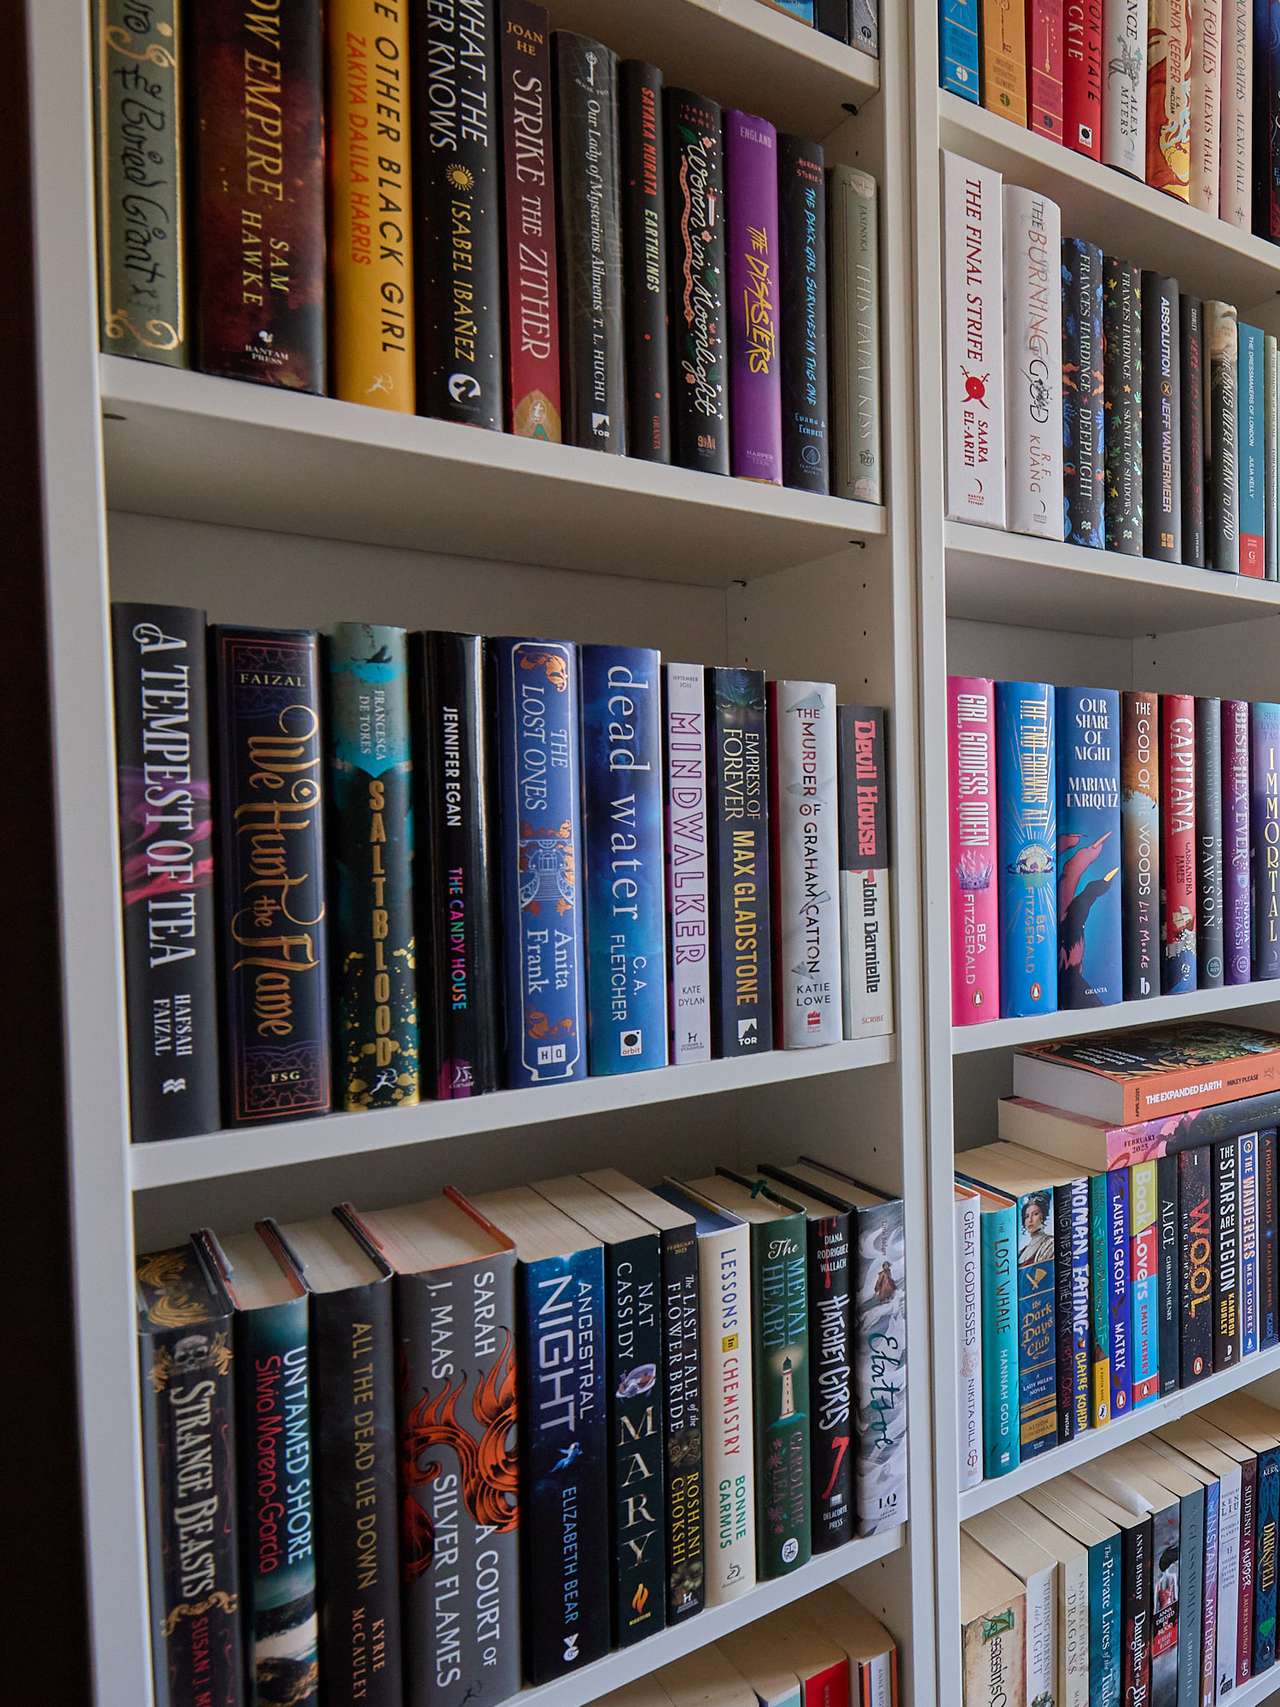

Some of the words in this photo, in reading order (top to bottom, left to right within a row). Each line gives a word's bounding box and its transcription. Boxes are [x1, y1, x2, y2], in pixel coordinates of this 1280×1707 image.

[346, 32, 367, 110] ZAKIYA
[374, 37, 400, 144] OTHER
[121, 100, 165, 184] Buried
[243, 49, 282, 200] EMPIRE
[513, 69, 546, 186] STRIKE
[641, 87, 656, 141] SAYAKA
[348, 112, 368, 184] DALILA
[643, 143, 656, 195] MURATA
[351, 192, 371, 265] HARRIS
[378, 157, 403, 268] BLACK
[519, 194, 542, 239] THE
[965, 179, 982, 220] THE
[123, 184, 169, 284] Giant
[241, 209, 261, 307] HAWKE
[448, 199, 472, 273] ISABEL
[645, 209, 660, 293] EARTHLINGS
[965, 225, 982, 286] FINAL
[270, 238, 289, 292] SAM
[380, 281, 405, 353] GIRL
[519, 247, 551, 361] ZITHER
[967, 293, 983, 362] STRIFE
[1160, 297, 1171, 377] ABSOLUTION
[963, 410, 975, 467] EL-ARIFI
[977, 419, 990, 463] SAARA
[1161, 398, 1171, 430] JEFF
[1030, 434, 1041, 493] KUANG
[1080, 409, 1093, 500] DEEPLIGHT
[1162, 433, 1172, 513] VANDERMEER
[132, 623, 187, 654] A
[240, 674, 306, 687] FAIZAL
[1079, 698, 1107, 714] OUR
[443, 707, 460, 778] JENNIFER
[522, 684, 546, 744] LOST
[608, 666, 649, 772] dead
[1075, 715, 1110, 730] SHARE
[1084, 730, 1103, 745] OF
[141, 665, 195, 830] TEMPEST
[551, 729, 568, 768] THE
[723, 728, 744, 822] FOREVER
[745, 733, 760, 804] EMPRESS
[854, 720, 877, 780] Devil
[1075, 746, 1111, 761] NIGHT
[1169, 718, 1194, 833] CAPITANA
[446, 783, 461, 826] EGAN
[520, 749, 547, 810] ONES
[1067, 793, 1120, 809] ENRIQUEZ
[1068, 777, 1118, 792] MARIANA
[670, 712, 706, 965] MINDWALKER
[747, 807, 760, 819] OF
[856, 786, 879, 856] House
[957, 802, 989, 847] QUEEN
[146, 840, 194, 884] OF
[610, 794, 645, 921] water
[733, 830, 755, 876] MAX
[1264, 748, 1280, 942] IMMORTAL
[449, 868, 463, 894] THE
[863, 879, 877, 917] John
[1202, 836, 1215, 928] DAWSON
[148, 893, 196, 968] TEA
[368, 780, 392, 1067] SALTBLOOD
[449, 900, 464, 955] CANDY
[733, 883, 757, 1006] GLADSTONE
[963, 893, 976, 984] FITZGERALD
[977, 923, 986, 954] BEA
[451, 959, 467, 1010] HOUSE
[527, 929, 549, 994] Frank
[555, 929, 573, 990] Anita
[610, 934, 626, 1021] FLETCHER
[796, 983, 830, 993] KATIE
[864, 921, 881, 994] Darnielle
[678, 995, 705, 1006] DYLAN
[681, 985, 701, 995] KATE
[796, 995, 830, 1006] LOWE
[154, 999, 171, 1056] FAIZAL
[174, 994, 192, 1056] HAFSAH
[622, 1046, 641, 1055] orbit
[738, 1037, 757, 1046] TOR
[271, 1071, 300, 1082] FSG
[1160, 1086, 1199, 1102] EXPANDED
[1199, 1079, 1223, 1093] EARTH
[1220, 1145, 1235, 1159] THE
[1220, 1159, 1235, 1219] STARS
[1242, 1177, 1256, 1260] WANDERERS
[1112, 1195, 1124, 1246] LAUREN
[1220, 1215, 1235, 1229] ARE
[427, 1282, 453, 1297] J.
[720, 1249, 738, 1329] LESSONS
[1113, 1248, 1125, 1296] GROFF
[1220, 1230, 1236, 1292] LEGION
[474, 1271, 496, 1358] SARAH
[617, 1262, 634, 1360] CASSIDY
[638, 1283, 654, 1327] NAT
[352, 1323, 373, 1359] ALL
[430, 1305, 454, 1380] MAAS
[538, 1275, 576, 1432] NIGHT
[577, 1282, 595, 1420] ANCESTRAL
[1075, 1352, 1087, 1391] CLAIRE
[1114, 1322, 1126, 1371] MATRIX
[353, 1363, 374, 1404] THE
[1000, 1349, 1008, 1401] HANNAH
[283, 1346, 310, 1474] UNTAMED
[722, 1358, 740, 1457] CHEMISTRY
[1000, 1404, 1009, 1436] GOLD
[1075, 1393, 1088, 1432] KOHDA
[354, 1414, 375, 1470] DEAD
[356, 1478, 376, 1509] LIE
[617, 1406, 657, 1569] MARY
[686, 1472, 699, 1558] ROSHANI
[719, 1480, 732, 1550] GARMUS
[735, 1475, 747, 1541] BONNIE
[286, 1479, 312, 1564] SHORE
[433, 1474, 458, 1570] SILVER
[475, 1524, 498, 1543] A
[562, 1486, 578, 1576] ELIZABETH
[671, 1477, 686, 1565] CHOKSHI
[356, 1515, 377, 1590] DOWN
[475, 1550, 500, 1642] COURT
[564, 1583, 579, 1624] BEAR
[435, 1575, 461, 1687] FLAMES
[483, 1647, 496, 1667] OF
